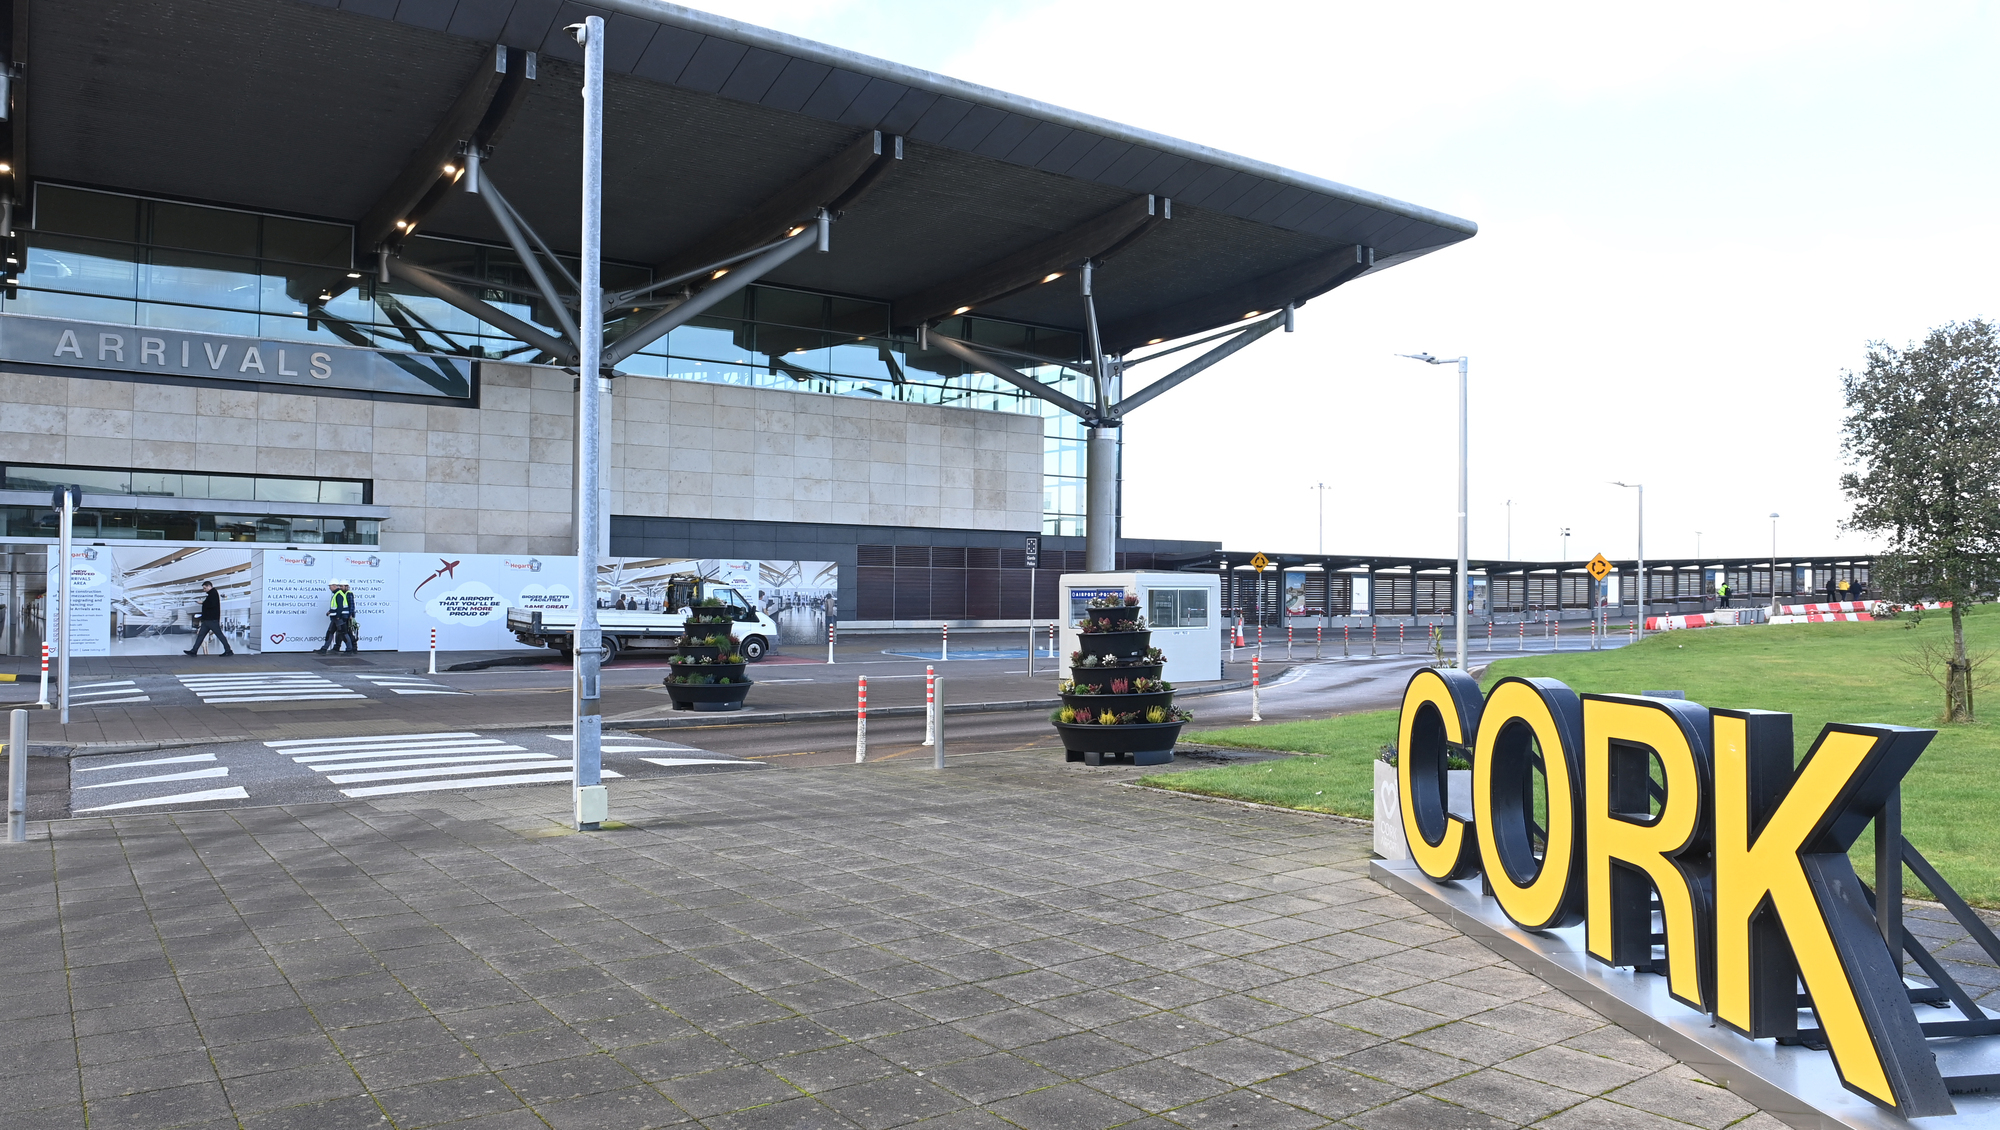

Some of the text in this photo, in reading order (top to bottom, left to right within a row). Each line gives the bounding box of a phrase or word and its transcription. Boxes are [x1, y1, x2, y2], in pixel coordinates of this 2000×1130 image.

[53, 329, 333, 380] ARRIVALS
[1381, 820, 1397, 840] CORK
[1397, 667, 1900, 1117] CORK
